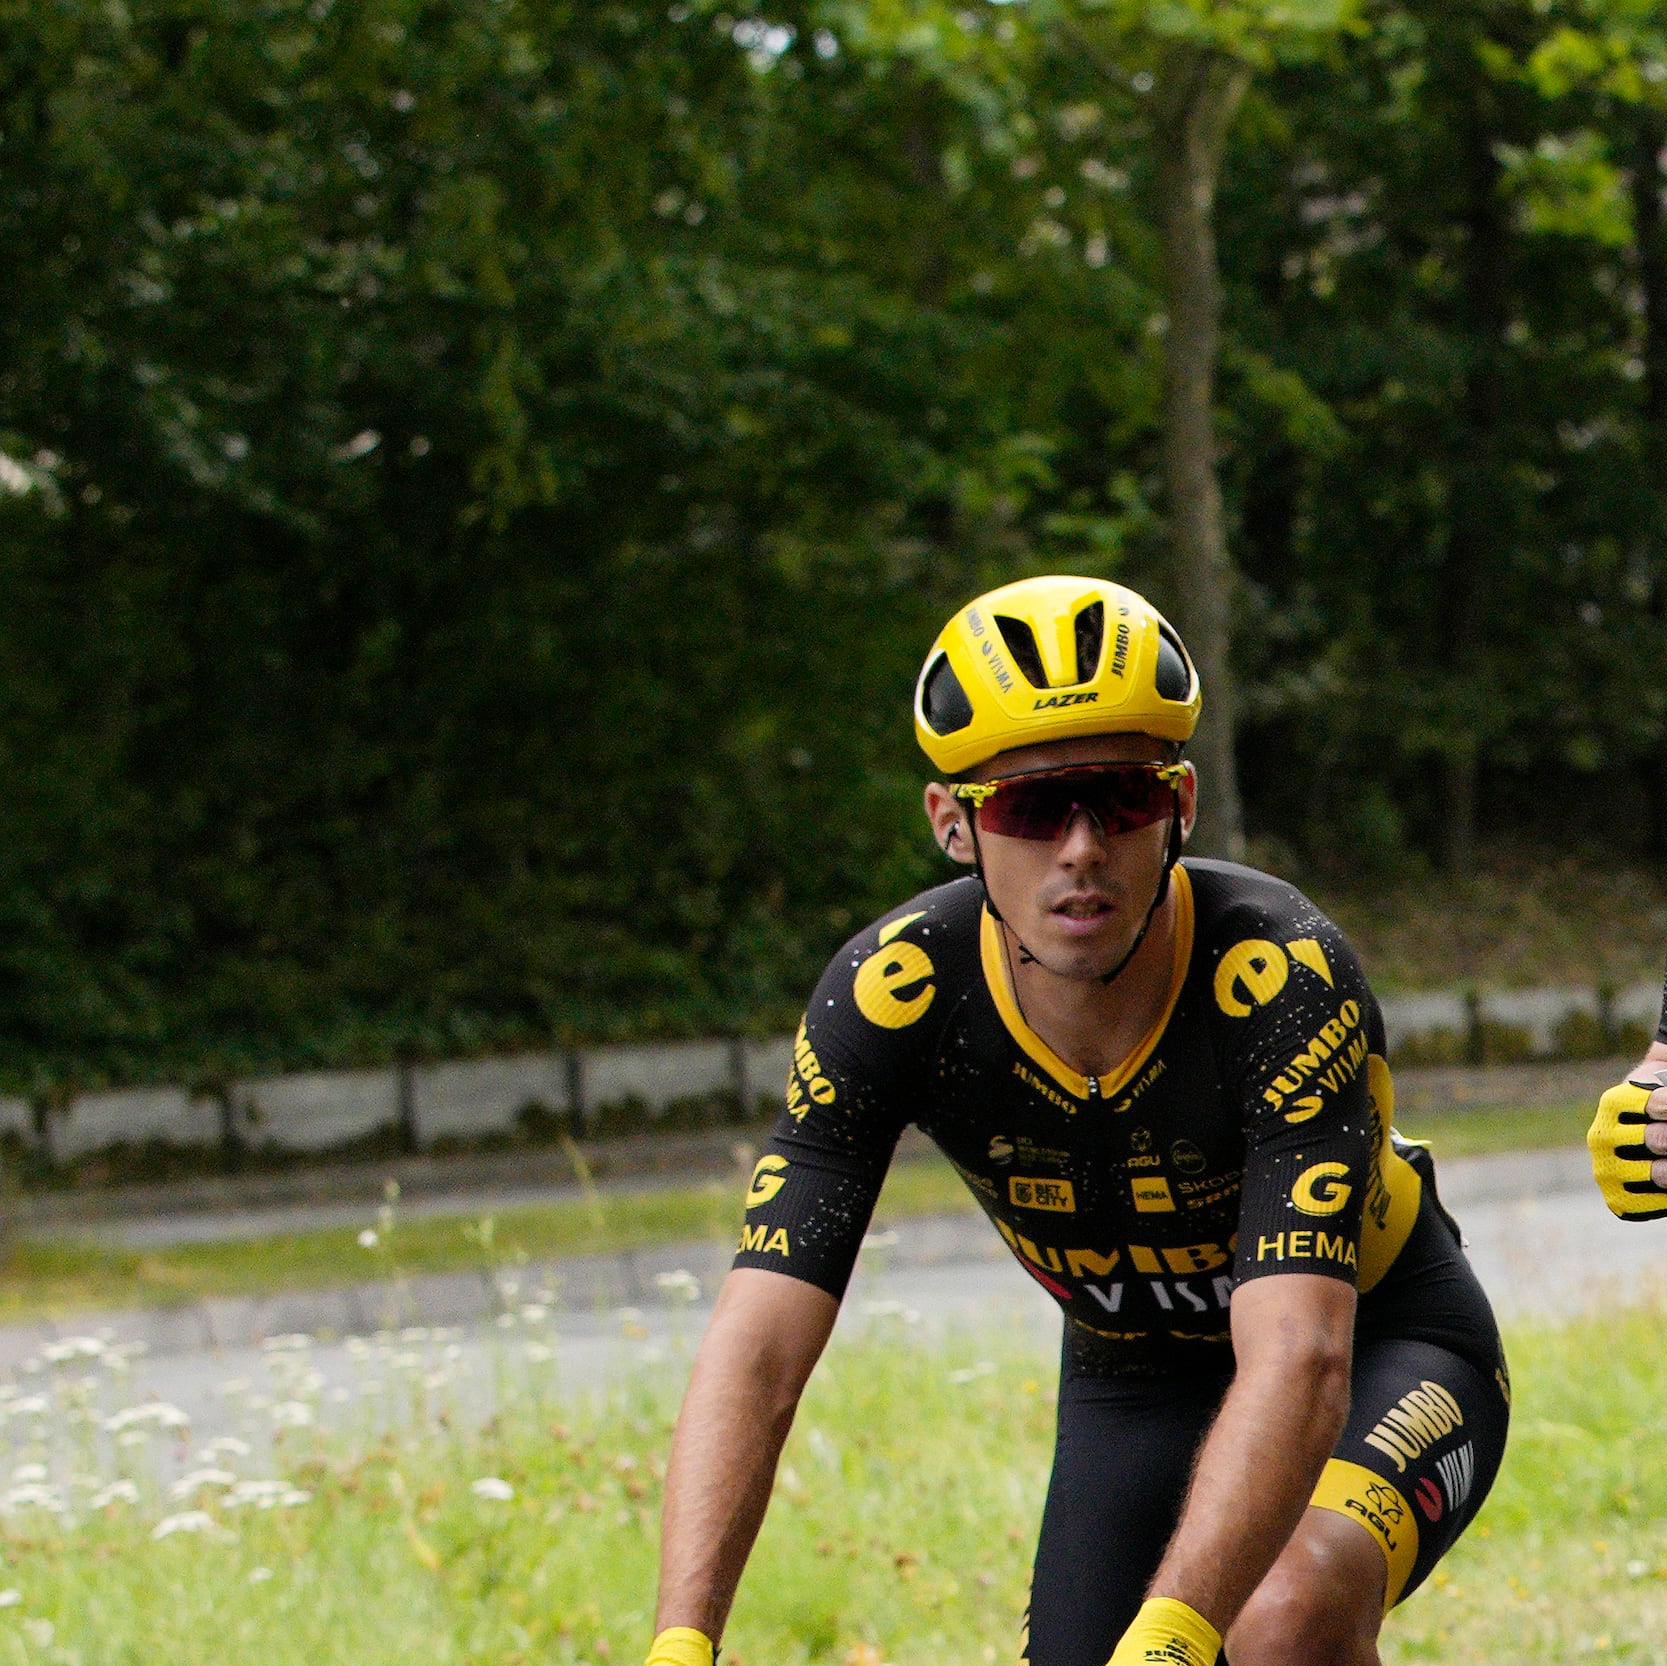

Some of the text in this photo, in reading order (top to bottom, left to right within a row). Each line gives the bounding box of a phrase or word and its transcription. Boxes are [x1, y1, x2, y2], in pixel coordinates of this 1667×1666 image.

[1112, 623, 1130, 679] JUMBO
[1034, 692, 1099, 711] LAZER
[1263, 999, 1361, 1113] JUMBO
[738, 1224, 790, 1256] MA
[994, 1217, 1240, 1278] UMB
[1257, 1230, 1358, 1272] HEMA
[1083, 1275, 1234, 1313] VIS
[1364, 1379, 1465, 1473] JUMBO
